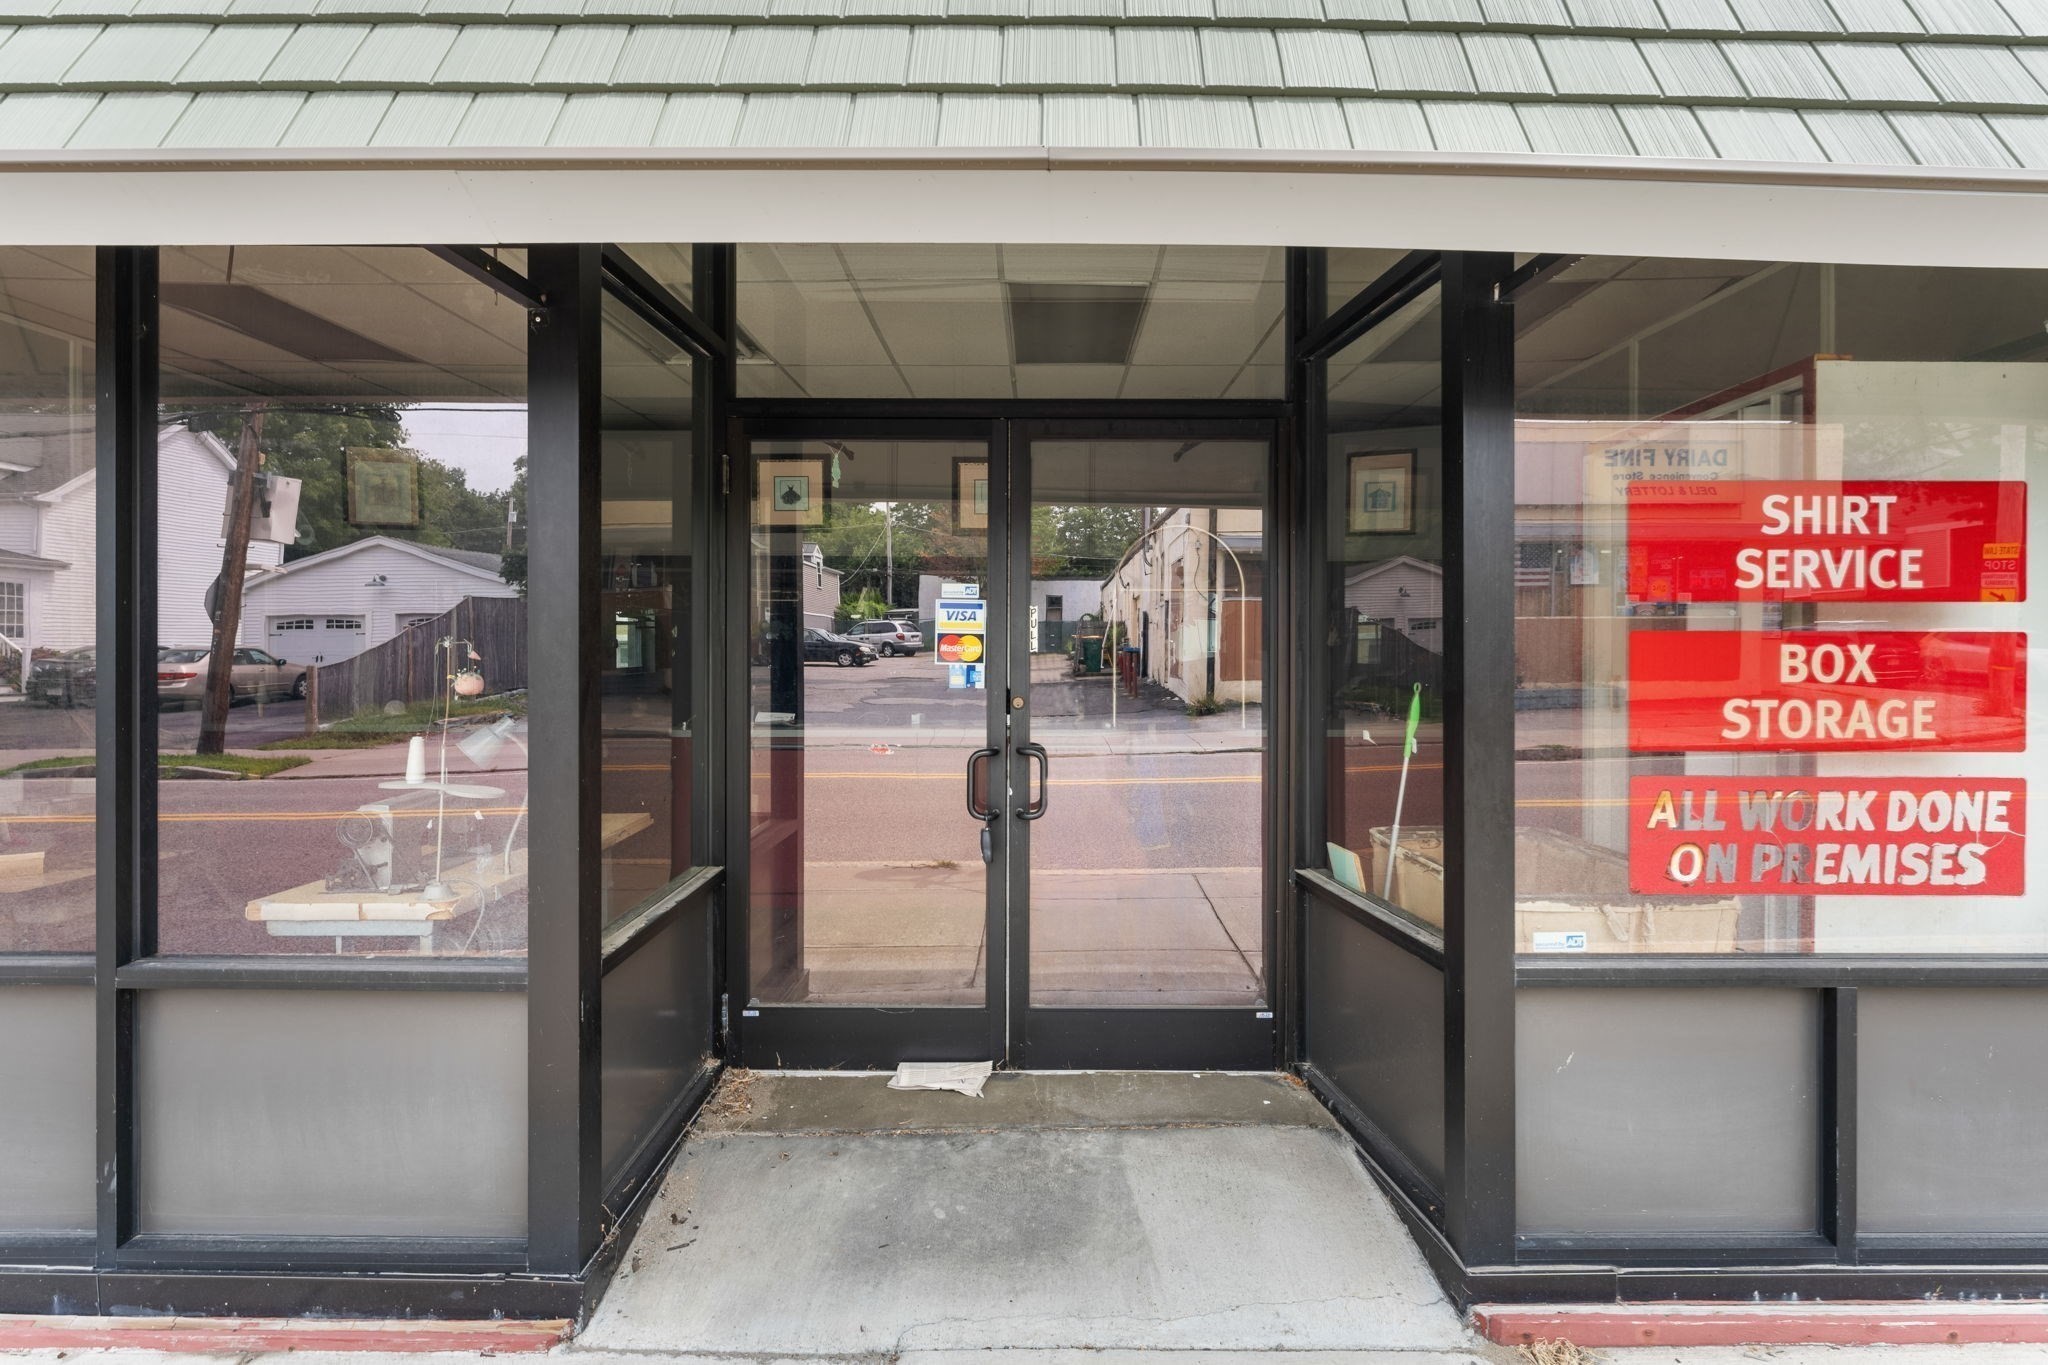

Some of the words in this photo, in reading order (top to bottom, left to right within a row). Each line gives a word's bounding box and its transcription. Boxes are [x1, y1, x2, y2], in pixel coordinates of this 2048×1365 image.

[1760, 494, 1898, 535] SHIRT
[1734, 548, 1924, 589] SERVICE
[946, 610, 977, 622] VISA
[940, 643, 980, 653] MasterCard
[1780, 643, 1877, 684] BOX
[1721, 698, 1937, 739] STORAGE
[1646, 789, 1727, 832] ALL
[1737, 789, 1878, 832] WORK
[1886, 789, 2013, 833] DONE
[1667, 842, 1738, 884] ON
[1750, 841, 1988, 885] PREMISES
